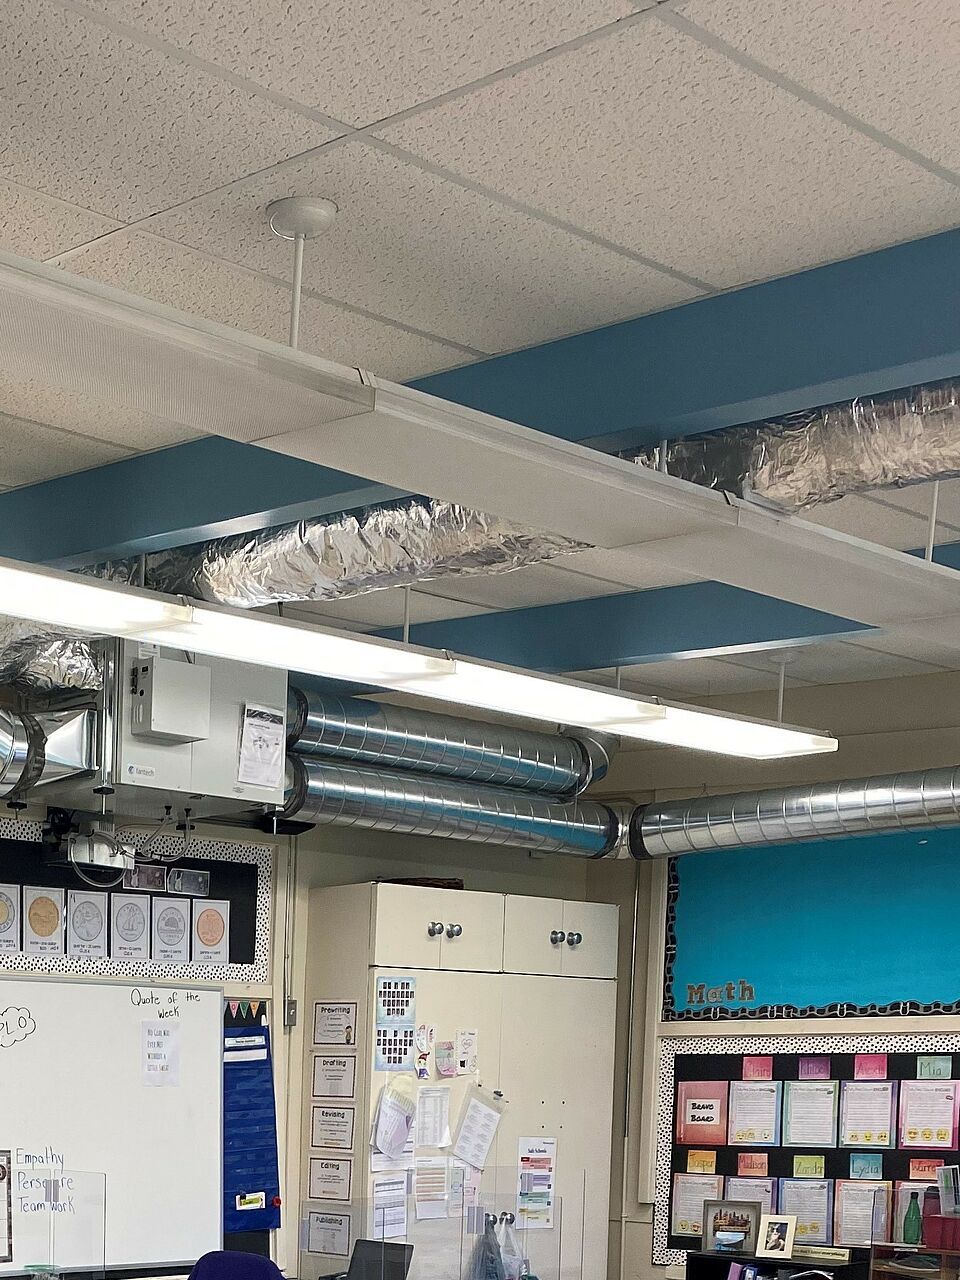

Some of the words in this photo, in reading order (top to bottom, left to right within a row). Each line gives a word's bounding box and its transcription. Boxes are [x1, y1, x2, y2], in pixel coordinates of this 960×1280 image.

[130, 988, 160, 1006] Quote
[167, 991, 177, 1004] of
[185, 992, 201, 1002] the
[687, 979, 756, 1005] Math
[920, 1062, 942, 1076] Mia
[16, 1145, 64, 1175] Empathy
[852, 1159, 878, 1177] Lydia
[912, 1162, 938, 1173] Warre
